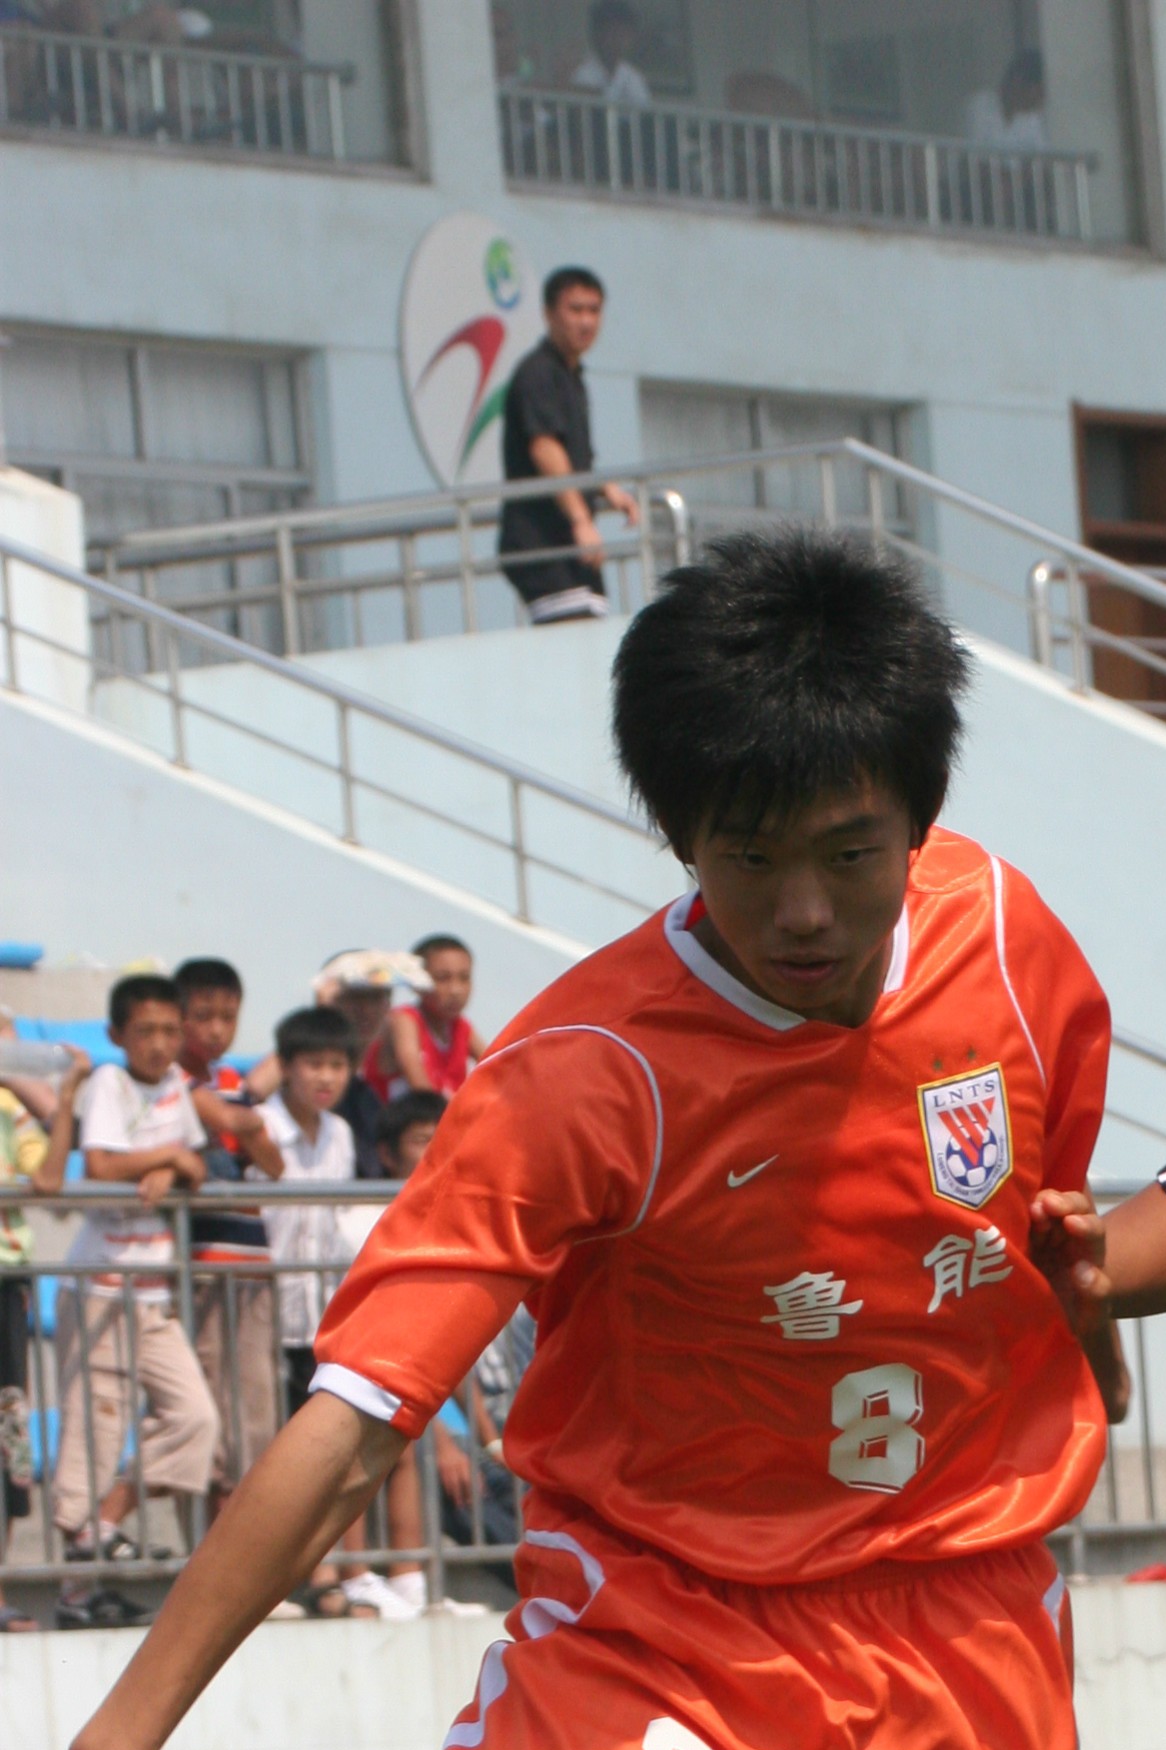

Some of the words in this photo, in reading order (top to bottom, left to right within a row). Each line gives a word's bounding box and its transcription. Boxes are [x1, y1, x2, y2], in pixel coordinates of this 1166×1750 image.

[933, 1079, 996, 1108] LNTS
[760, 1225, 1014, 1340] 鲁能
[828, 1362, 925, 1494] 8
